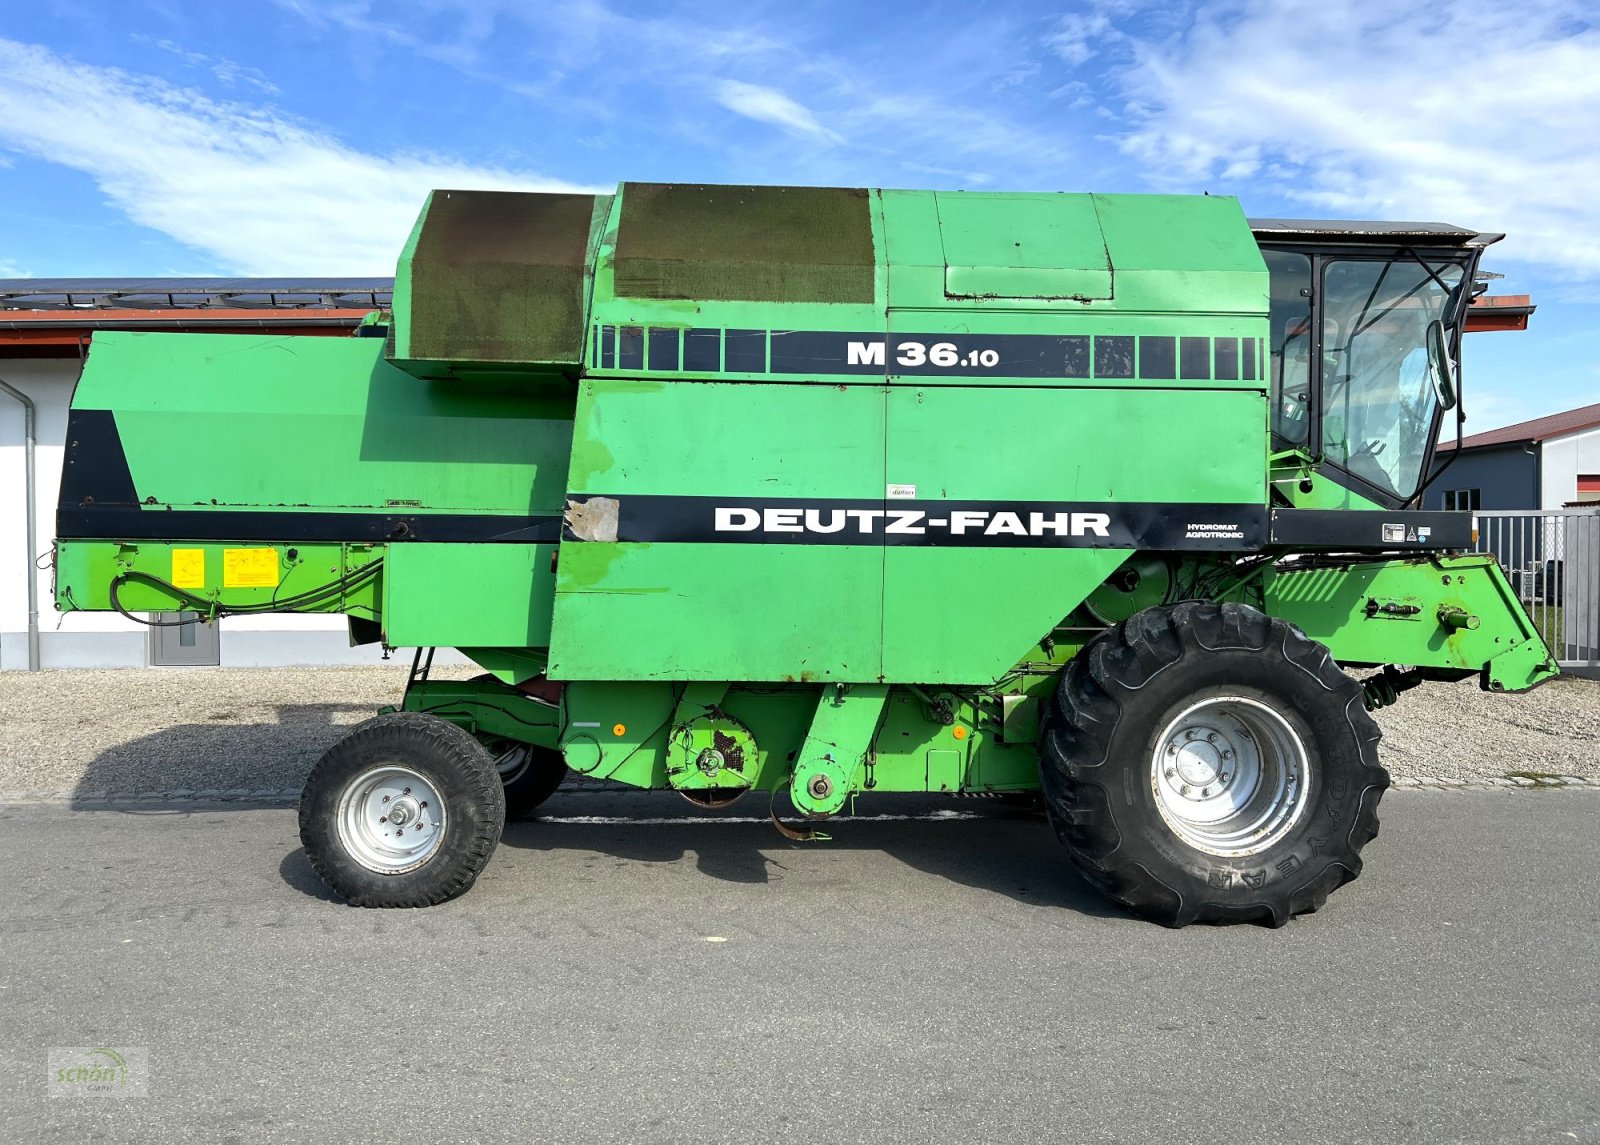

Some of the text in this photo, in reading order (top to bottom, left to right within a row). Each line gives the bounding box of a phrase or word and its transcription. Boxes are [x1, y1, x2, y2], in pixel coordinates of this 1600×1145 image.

[847, 341, 1000, 367] M 36.10
[714, 506, 1111, 538] DEUTZ-FAHR
[1187, 523, 1239, 532] HYDROMAT
[1185, 531, 1245, 540] AGROTRONIC
